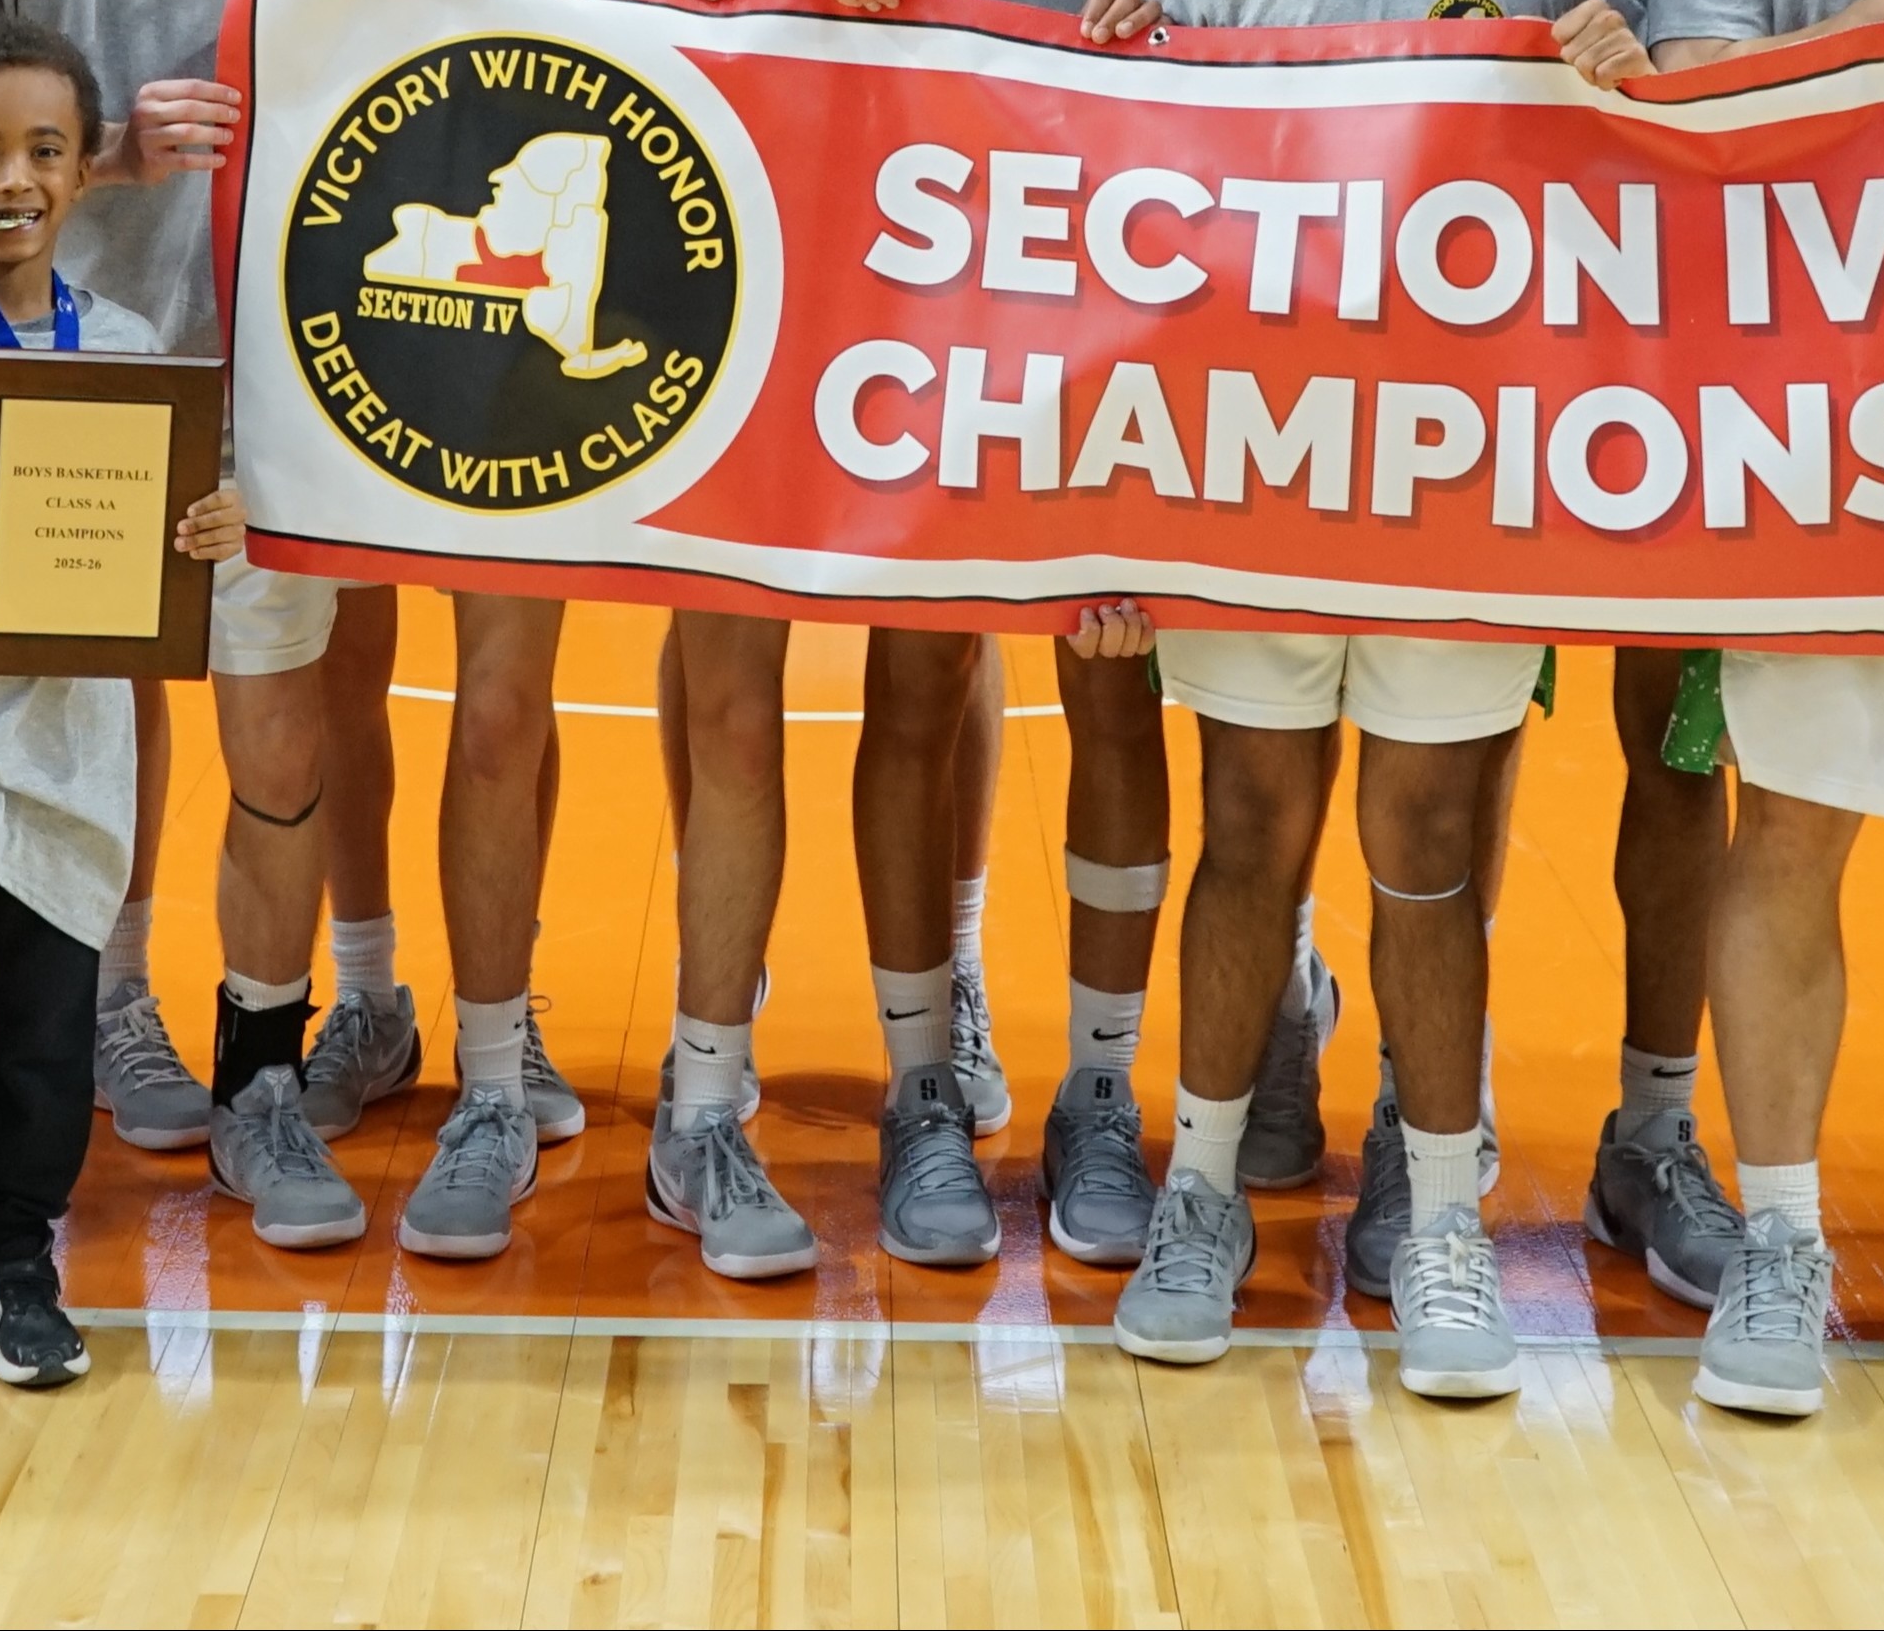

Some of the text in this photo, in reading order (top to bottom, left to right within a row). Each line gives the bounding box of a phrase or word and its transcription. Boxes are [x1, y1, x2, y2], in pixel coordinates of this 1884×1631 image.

[302, 49, 725, 273] VICTORY WITH HONOR
[863, 142, 1661, 327] SECTION
[356, 286, 519, 335] SECTION IV
[301, 310, 705, 498] DEFEAT WITH CLASS
[13, 465, 154, 482] BOYS BASKETBALL
[45, 497, 117, 511] CLASS AA
[34, 526, 125, 541] CHAMPIONS
[53, 557, 103, 571] 2025-26
